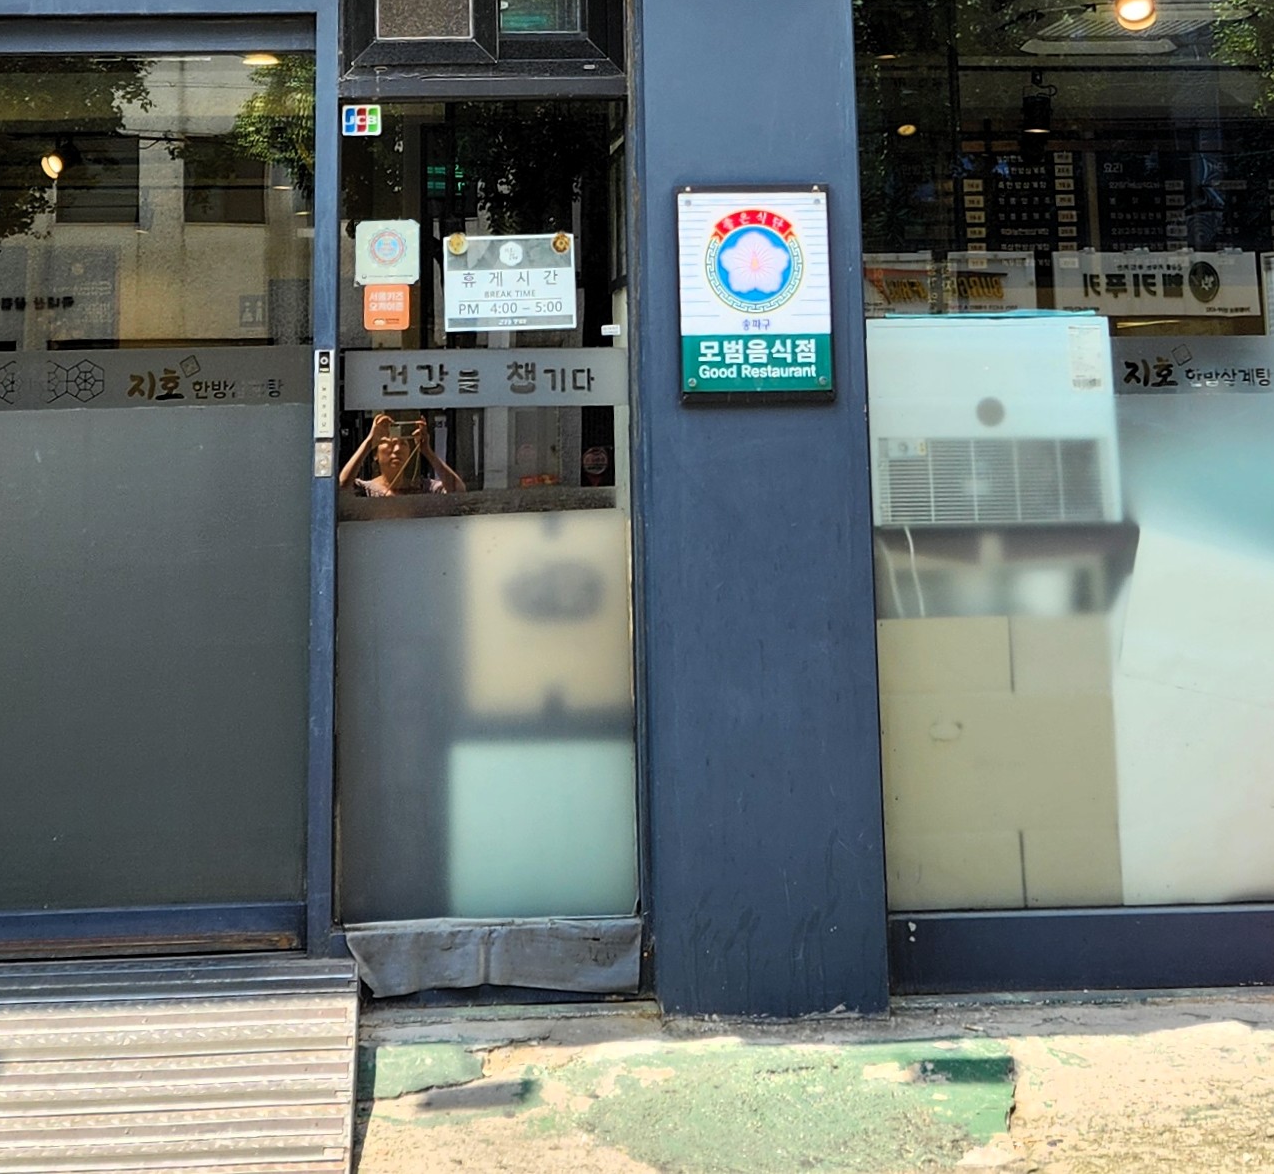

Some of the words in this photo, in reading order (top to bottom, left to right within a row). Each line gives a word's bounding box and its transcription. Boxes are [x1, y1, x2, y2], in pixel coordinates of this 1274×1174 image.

[484, 291, 512, 299] BREAK
[515, 289, 537, 298] TIME
[458, 303, 480, 315] PM
[490, 302, 518, 315] 4:00
[534, 300, 563, 313] 5:00
[742, 319, 771, 331] 송파구
[698, 338, 816, 363] 모범음식점
[506, 361, 595, 394] 챙기다
[699, 365, 737, 379] Good
[741, 364, 817, 378] Restaurant
[1123, 356, 1179, 387] 지호
[127, 368, 186, 400] 지호
